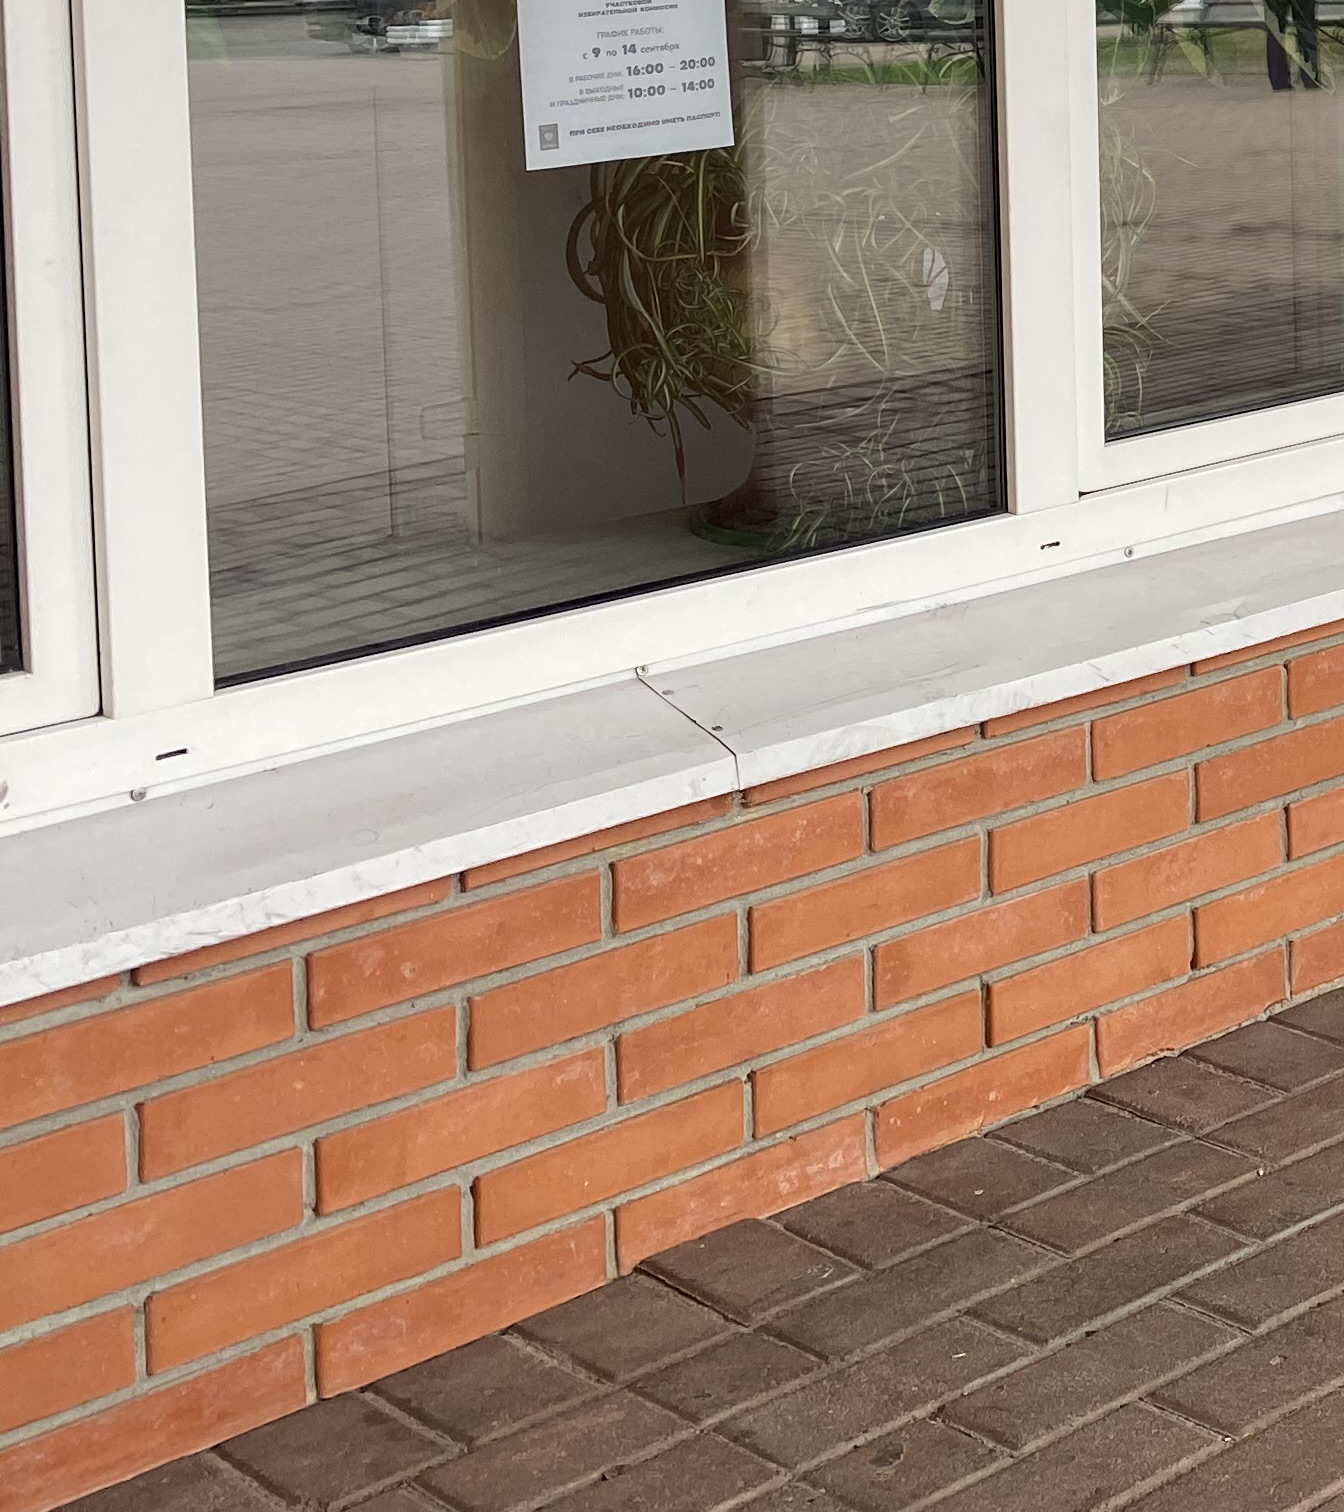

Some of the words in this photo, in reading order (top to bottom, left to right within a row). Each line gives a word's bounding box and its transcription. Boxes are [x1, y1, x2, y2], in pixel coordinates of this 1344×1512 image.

[597, 29, 628, 39] ГРАФИК
[631, 26, 664, 36] РАБОТЫ:
[592, 47, 601, 58] 9
[622, 44, 637, 55] 14
[641, 43, 679, 54] сентября
[626, 63, 664, 76] 16:00
[680, 57, 715, 71] 20:00
[628, 85, 665, 99] 10:00
[681, 79, 715, 92] 14:00
